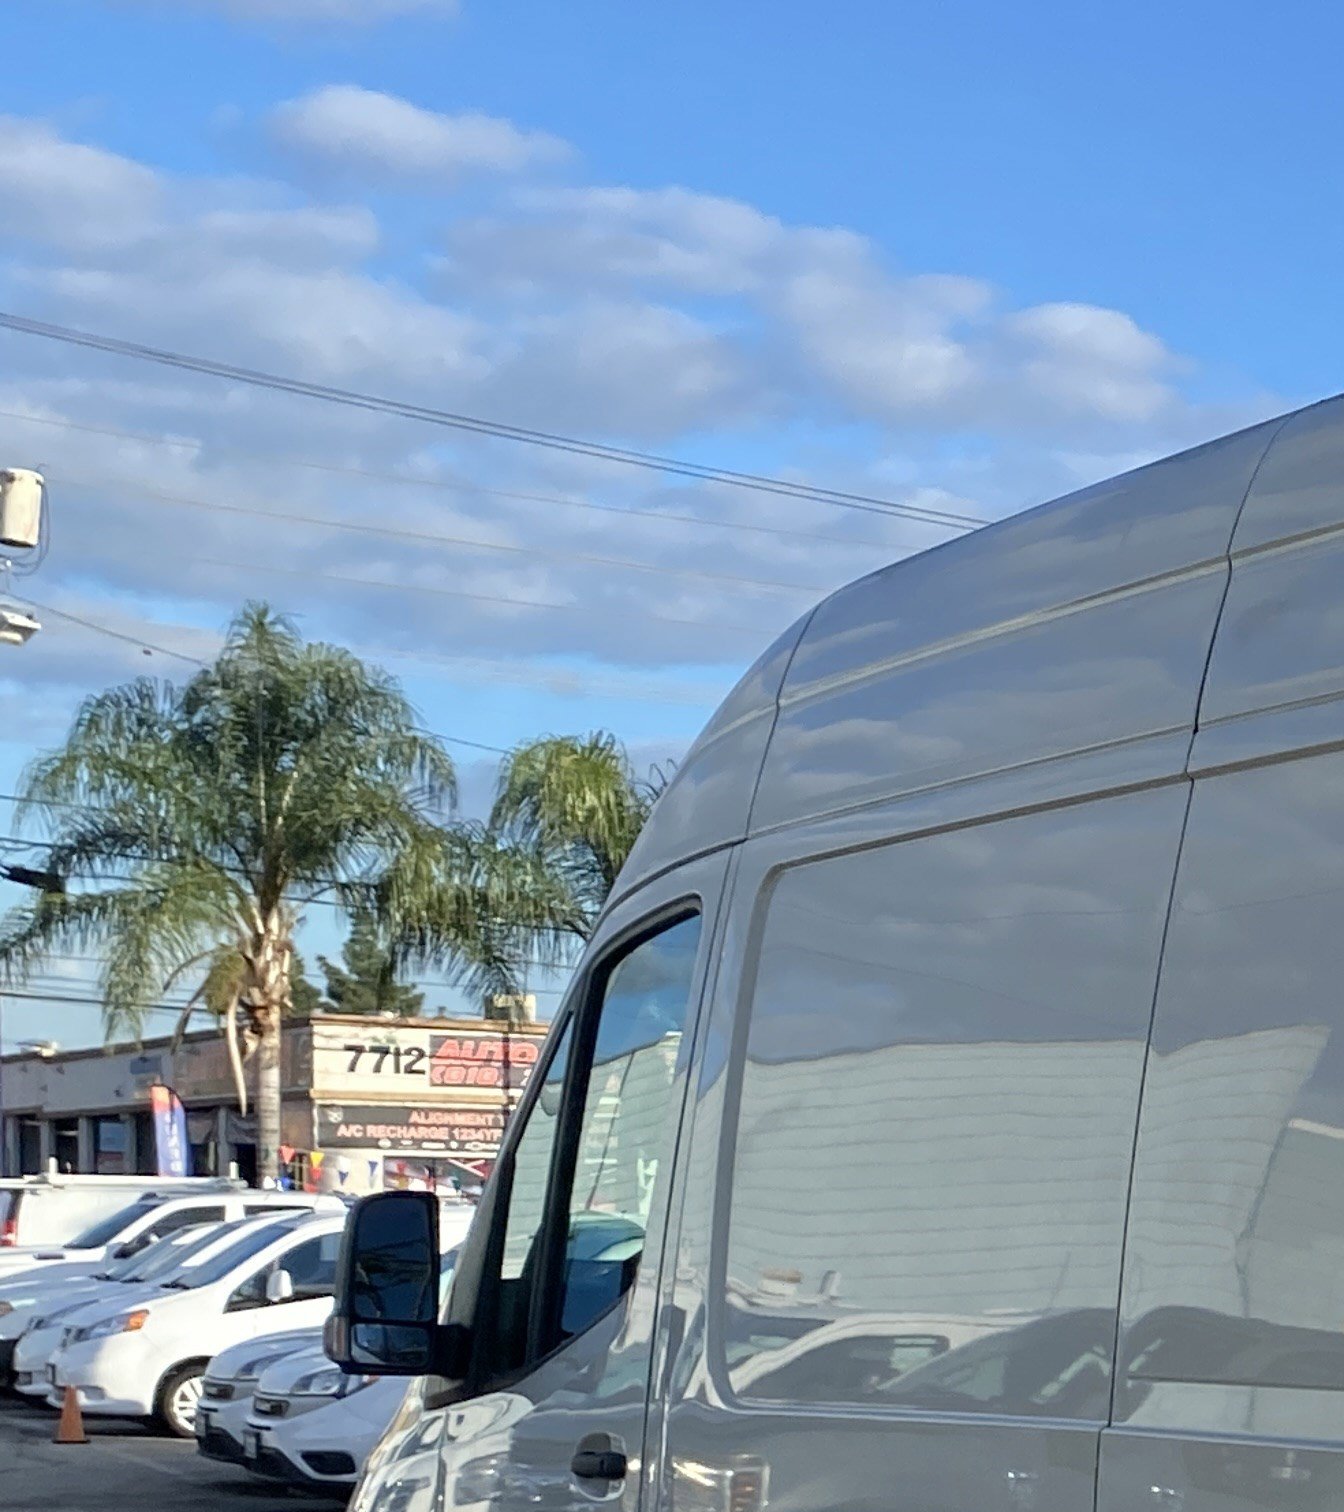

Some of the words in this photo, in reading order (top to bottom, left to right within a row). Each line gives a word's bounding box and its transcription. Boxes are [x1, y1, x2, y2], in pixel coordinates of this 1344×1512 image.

[344, 1044, 428, 1075] 7712
[431, 1038, 539, 1067] AUTO
[407, 1110, 495, 1127] ALIGNMENT
[336, 1123, 364, 1138] A/C
[366, 1124, 450, 1141] RECHARGE
